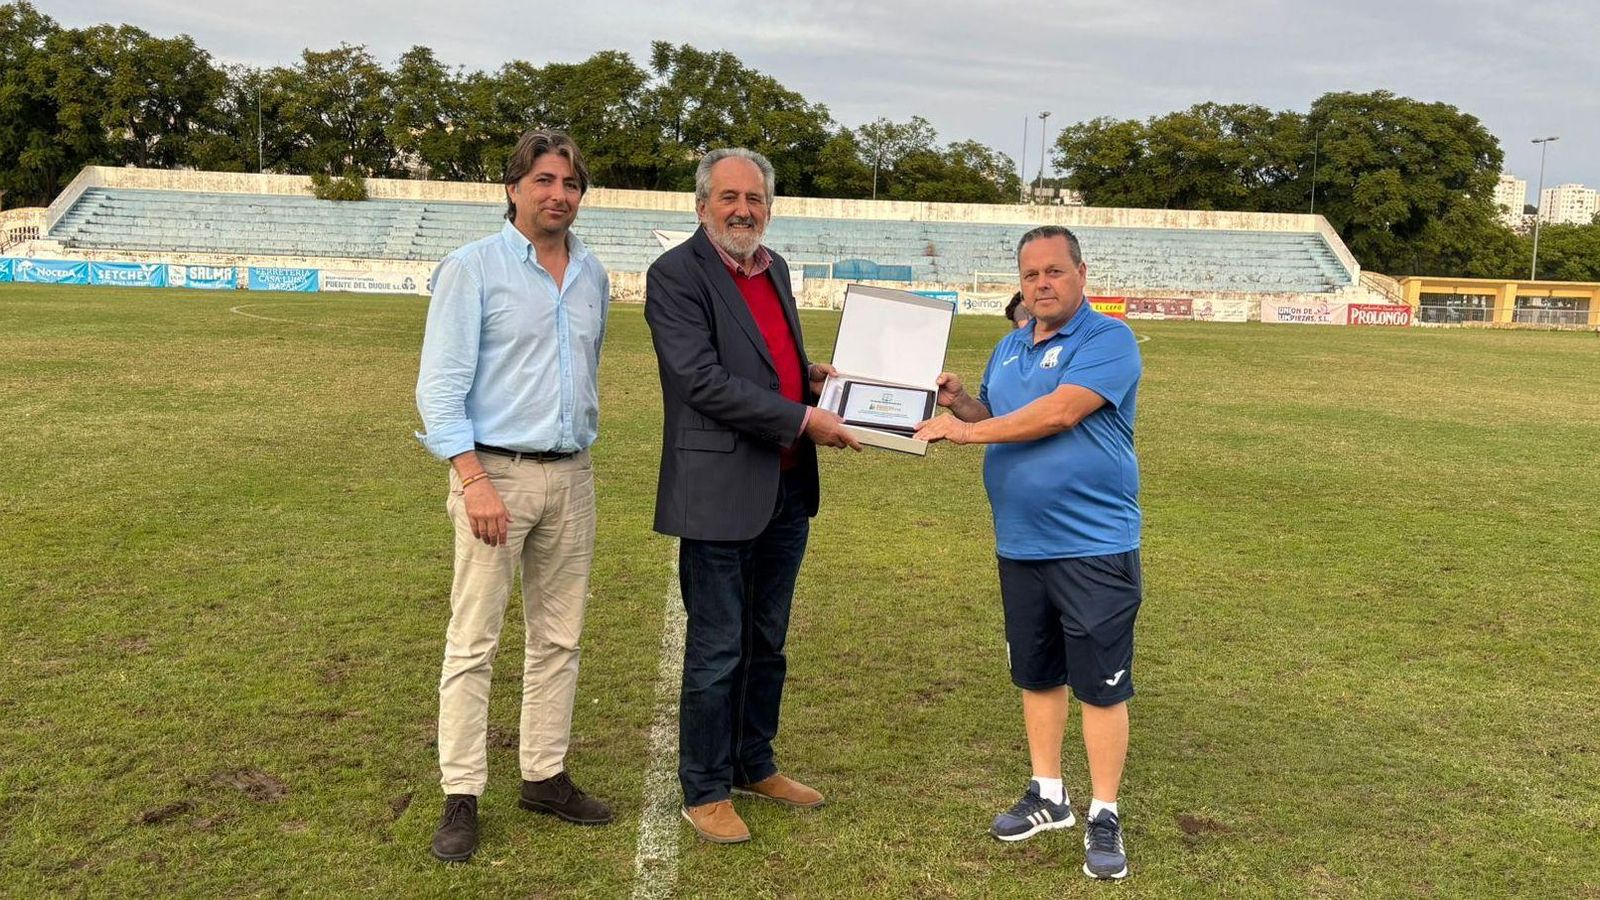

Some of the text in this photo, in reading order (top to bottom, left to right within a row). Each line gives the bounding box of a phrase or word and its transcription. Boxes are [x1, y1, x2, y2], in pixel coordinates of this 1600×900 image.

[98, 269, 151, 281] SETCHEY
[325, 280, 352, 288] PUENTE
[353, 281, 367, 289] DEL
[368, 281, 391, 290] DUQUE
[1350, 307, 1408, 326] PROLONGO
